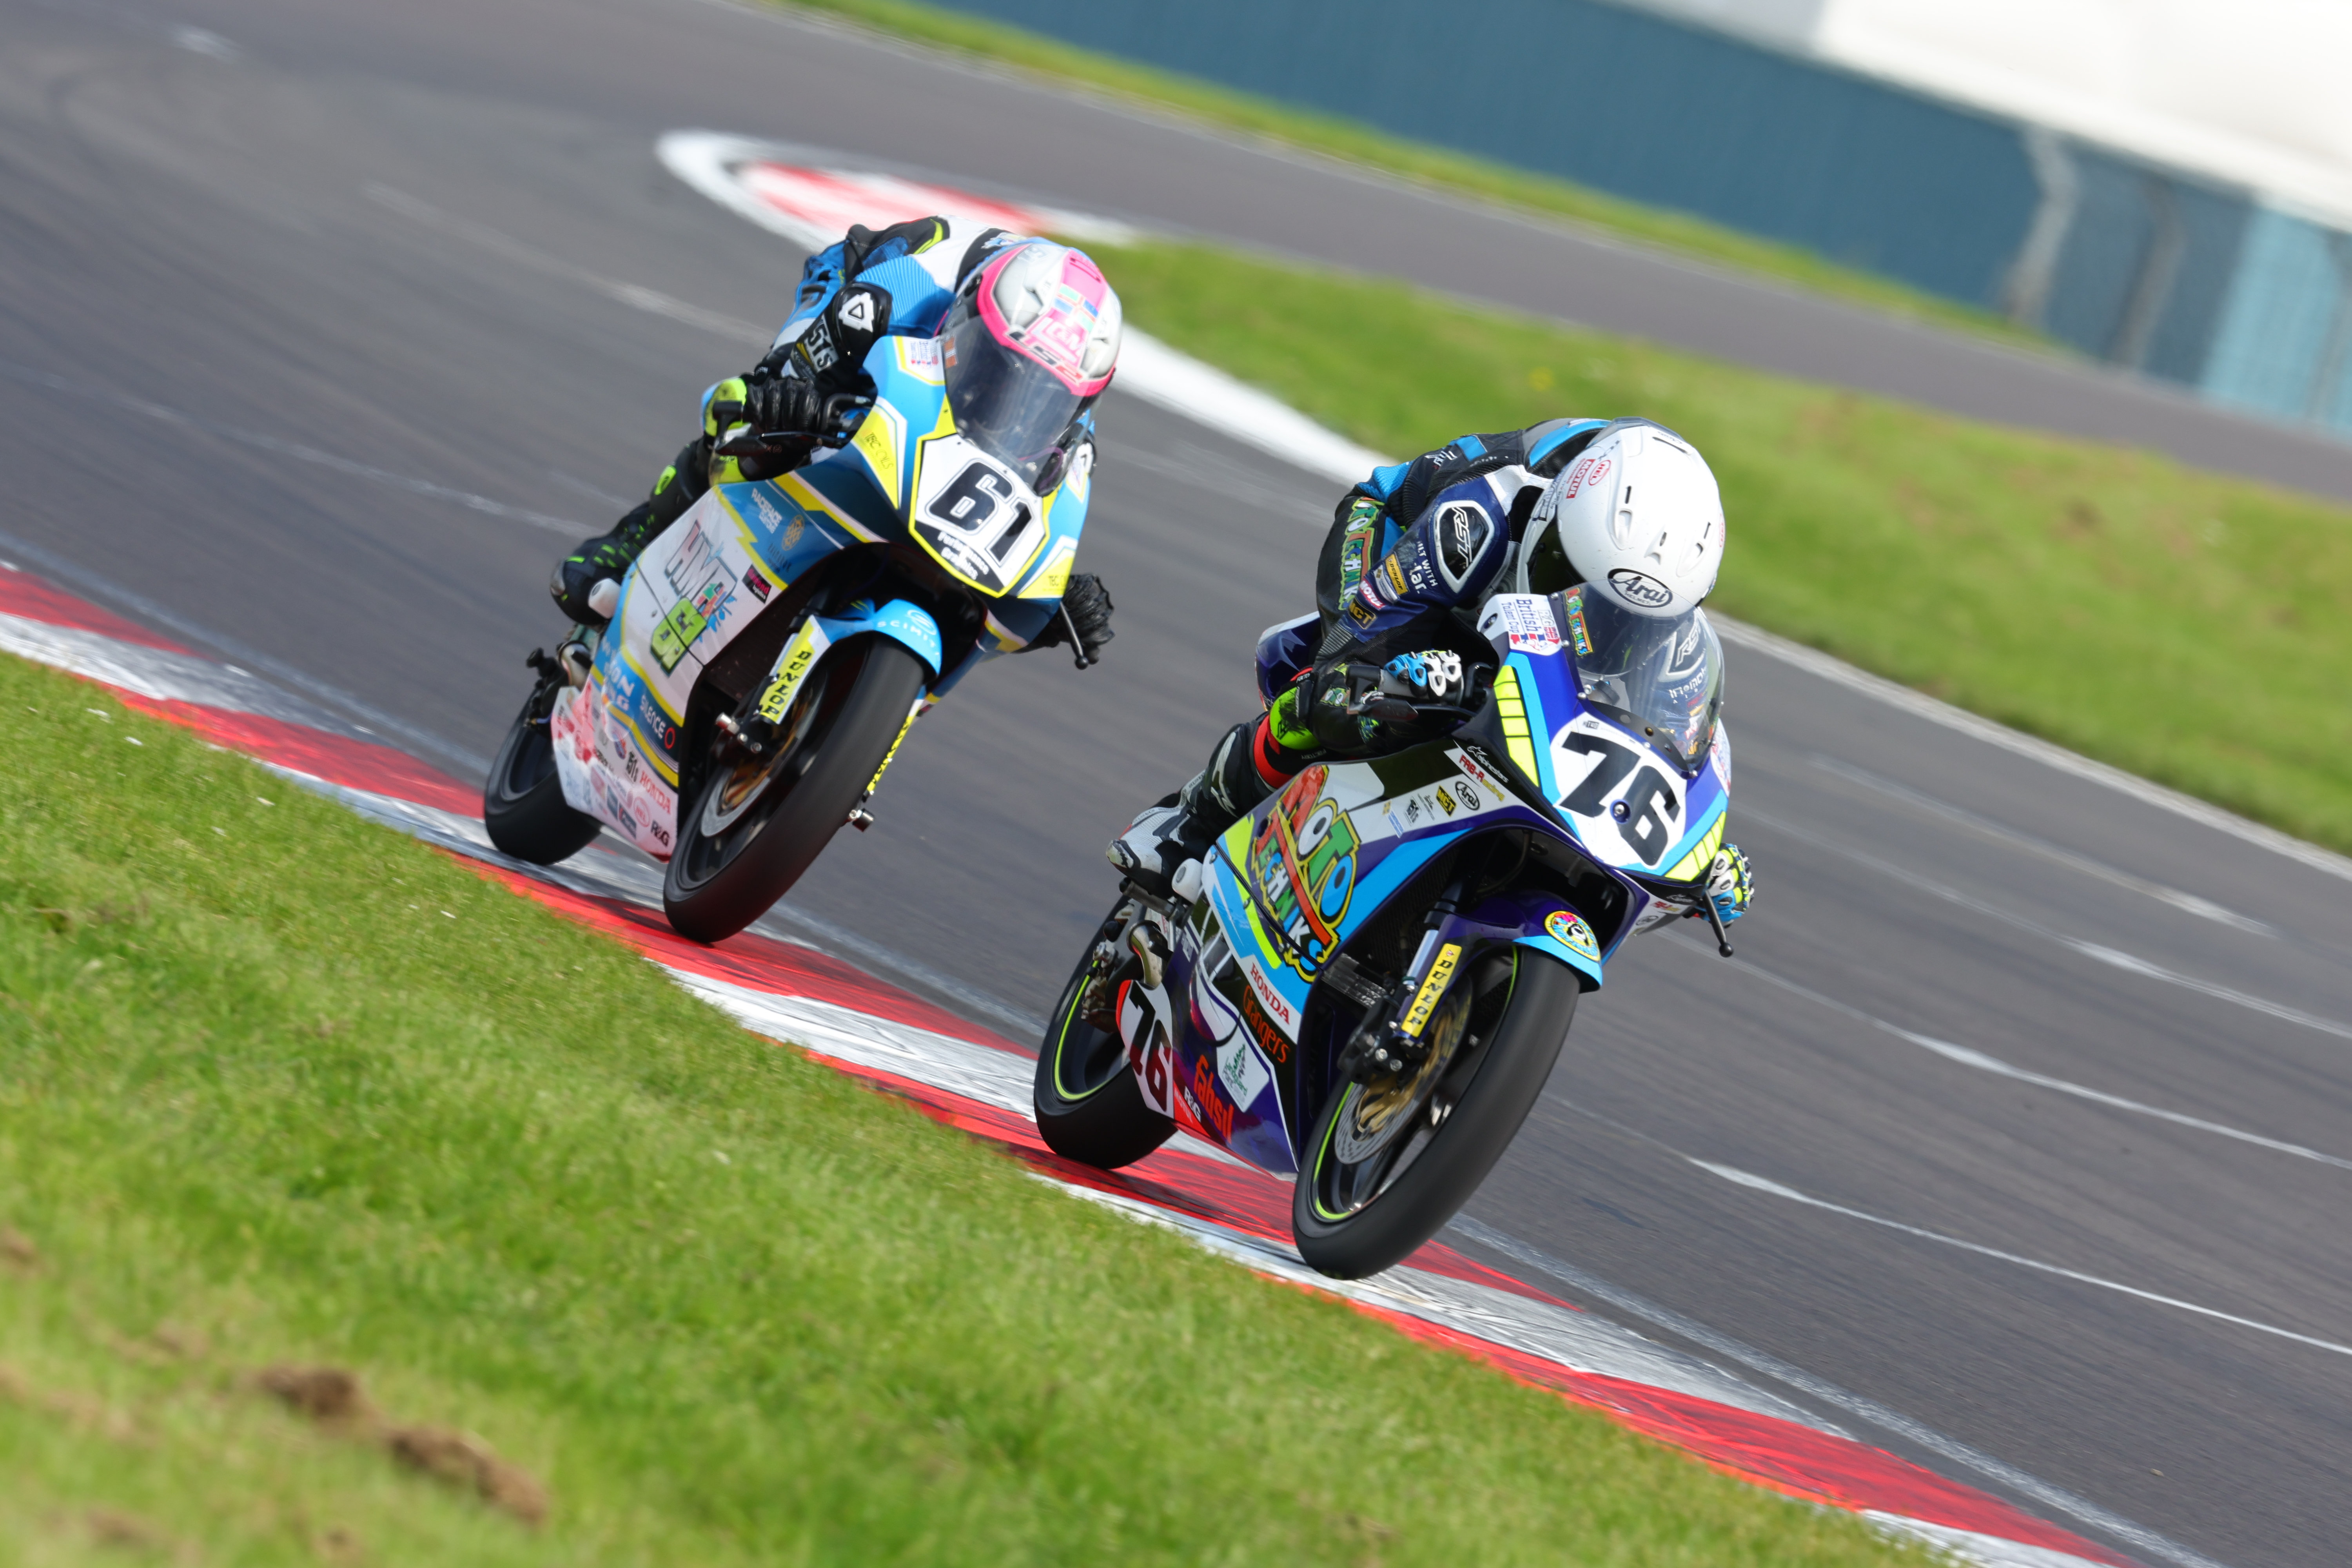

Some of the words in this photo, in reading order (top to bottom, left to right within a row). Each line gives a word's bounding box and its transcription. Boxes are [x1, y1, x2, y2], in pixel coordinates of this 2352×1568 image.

[1567, 460, 1593, 497] MOTUL
[927, 460, 1034, 565] 61
[1452, 506, 1472, 568] RST
[1359, 580, 1383, 607] MOTUL
[1388, 563, 1403, 590] DUNLOP
[1421, 559, 1438, 587] WITH
[1612, 575, 1669, 604] Arai
[877, 619, 940, 656] SCIMIT
[1501, 602, 1515, 622] Talent
[1509, 621, 1520, 633] Cup
[1516, 599, 1542, 632] British
[762, 650, 811, 717] DUNLOP
[640, 694, 666, 739] SILENCE
[639, 770, 671, 814] HONDA
[1459, 754, 1505, 802] FAB-Racing
[1559, 731, 1681, 866] 76
[650, 820, 670, 847] R&G
[1282, 765, 1355, 918] MOTO
[1255, 811, 1332, 971] TECHNIKS
[1250, 963, 1290, 1025] HONDA
[1408, 959, 1454, 1026] DUNLOP
[1129, 980, 1172, 1113] 76
[1184, 1085, 1202, 1123] R&G
[1193, 1054, 1235, 1145] fabsil
